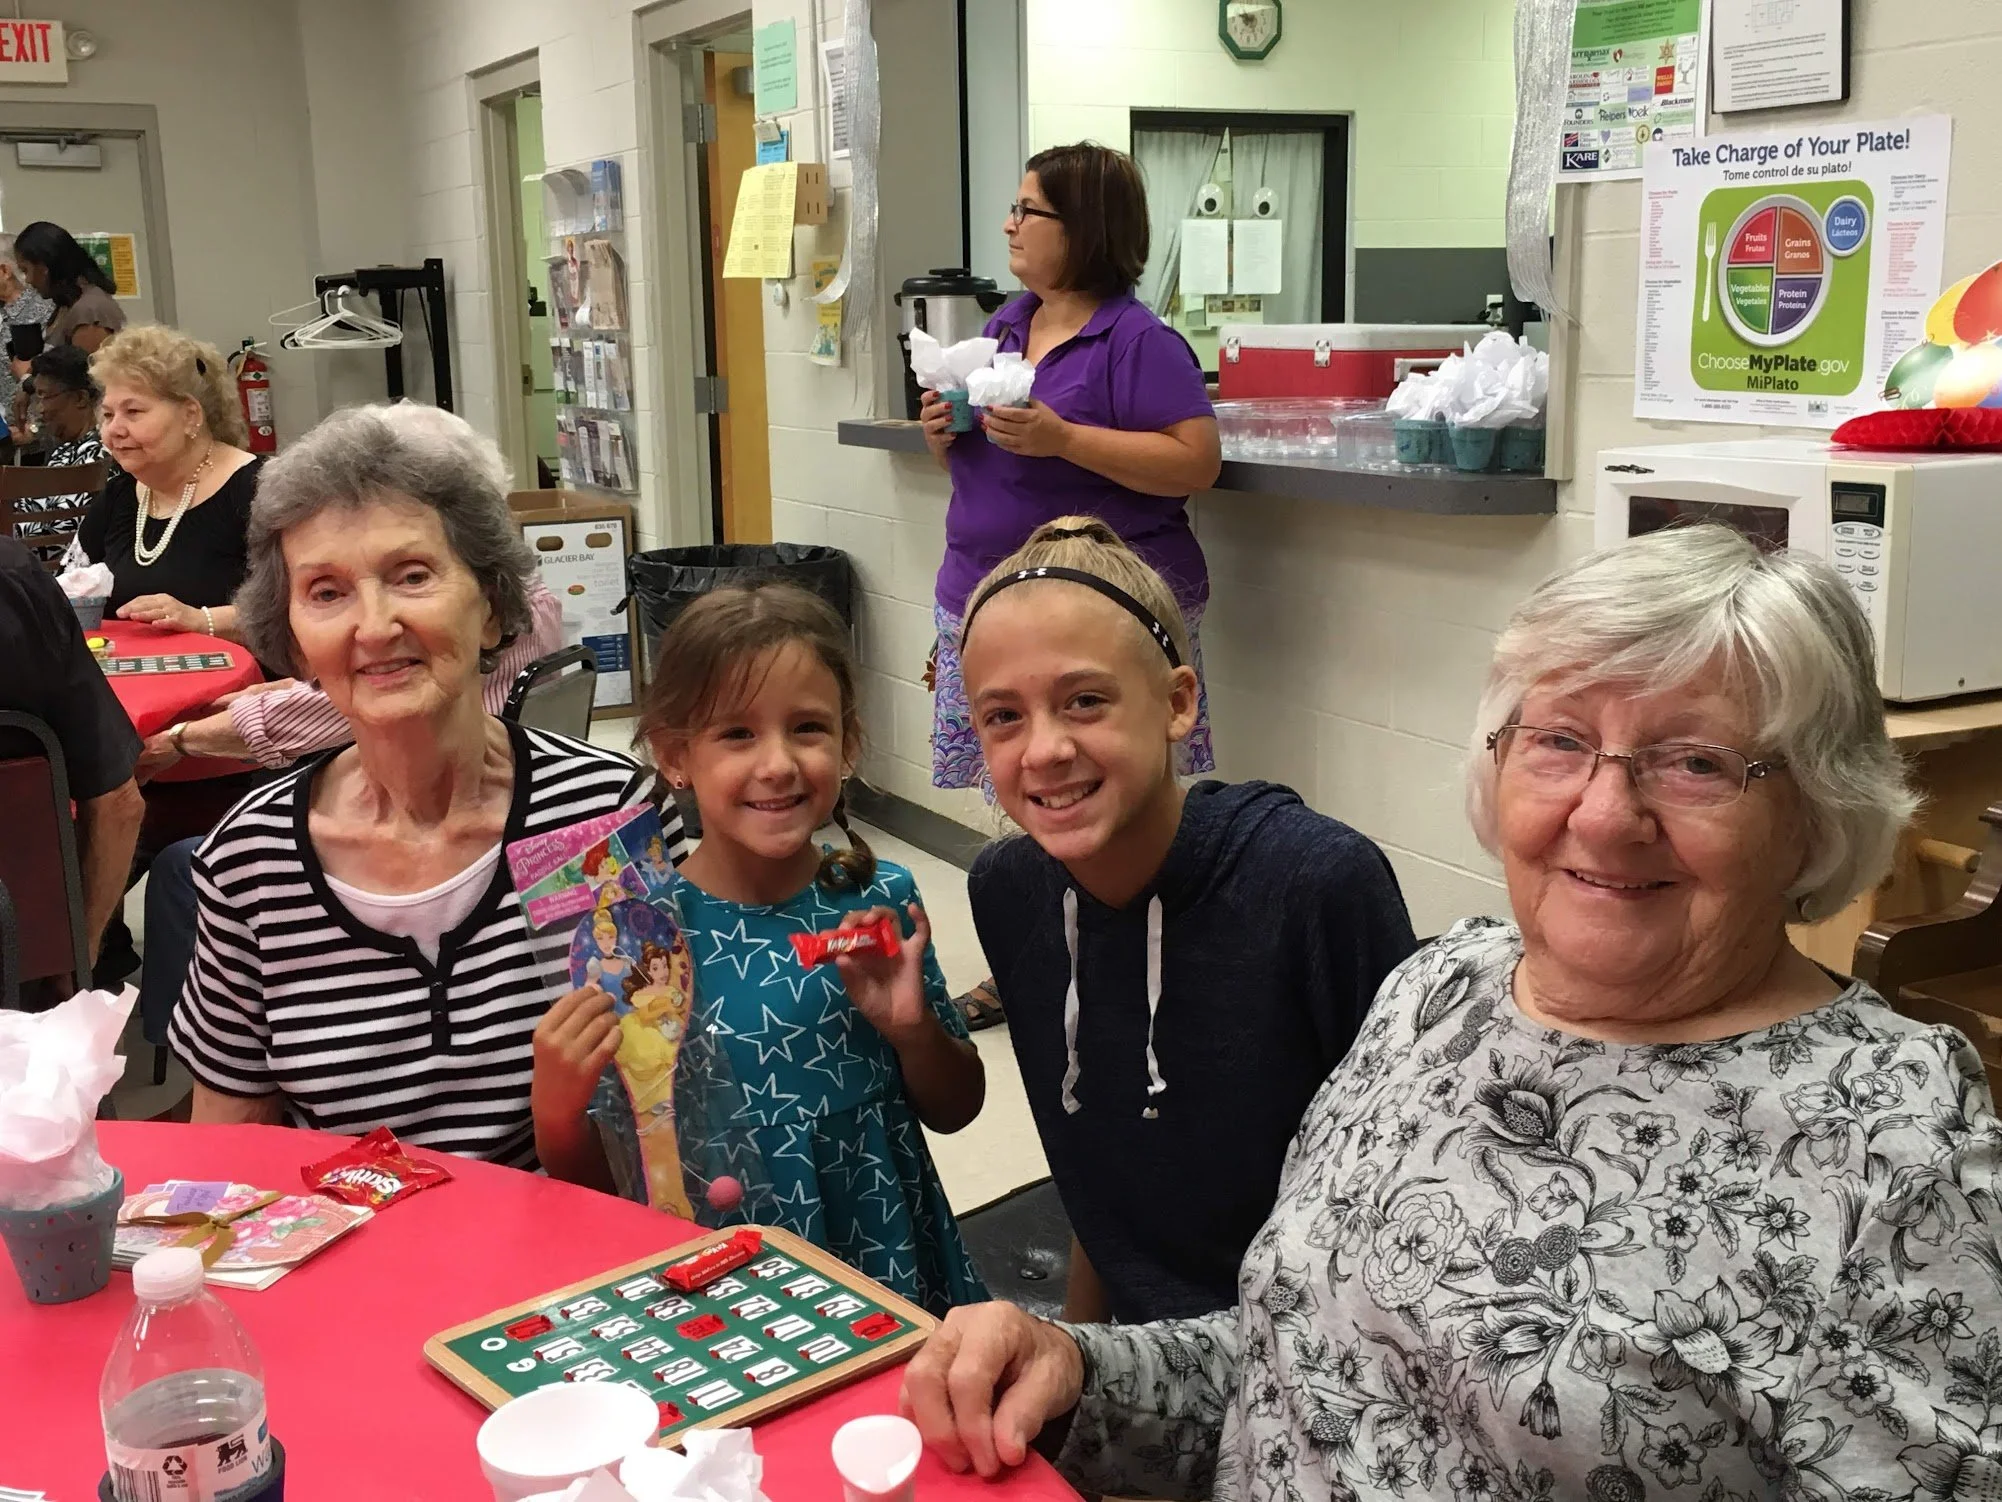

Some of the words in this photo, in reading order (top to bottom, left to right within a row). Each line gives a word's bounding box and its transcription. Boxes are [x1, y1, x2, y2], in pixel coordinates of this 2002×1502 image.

[0, 23, 51, 62] EXIT
[1660, 97, 1694, 107] Blackmon
[1673, 147, 1710, 167] Take
[1716, 143, 1779, 166] Charge
[1784, 138, 1802, 158] of
[1808, 136, 1851, 157] Your
[1857, 128, 1910, 153] Plate!
[1565, 151, 1598, 169] KARE
[1723, 169, 1750, 181] Tome
[1753, 163, 1789, 178] control
[1791, 163, 1804, 176] de
[1807, 166, 1819, 176] su
[1821, 161, 1852, 176] plato!
[1834, 216, 1857, 227] Dairy
[1745, 233, 1767, 243] Fruits
[1785, 238, 1811, 248] Grains
[1745, 245, 1766, 253] Frutas
[1784, 250, 1810, 259] Granos
[1730, 283, 1770, 294] Vegetables
[1778, 289, 1807, 299] Protein
[1736, 296, 1767, 307] Vegetales
[1698, 352, 1850, 376] ChooseMyPlate.gov
[1746, 375, 1799, 391] MiPlato
[543, 554, 578, 565] GLACIER
[579, 553, 595, 562] BAY
[757, 1260, 794, 1280] 56
[620, 1281, 660, 1296] 61
[782, 1279, 826, 1299] 37
[566, 1300, 606, 1317] 65
[647, 1297, 692, 1319] 58
[732, 1296, 771, 1316] 42
[821, 1299, 861, 1319] 29
[596, 1319, 638, 1339] 53
[767, 1319, 807, 1338] 17
[481, 1337, 507, 1351] O
[540, 1340, 582, 1362] 51
[627, 1338, 666, 1359] 44
[719, 1338, 760, 1362] 24
[802, 1339, 844, 1360] 10
[659, 1360, 701, 1382] 18
[754, 1364, 788, 1380] 8
[695, 1384, 737, 1406] 11
[218, 1463, 234, 1474] FOOD
[235, 1456, 248, 1468] LION
